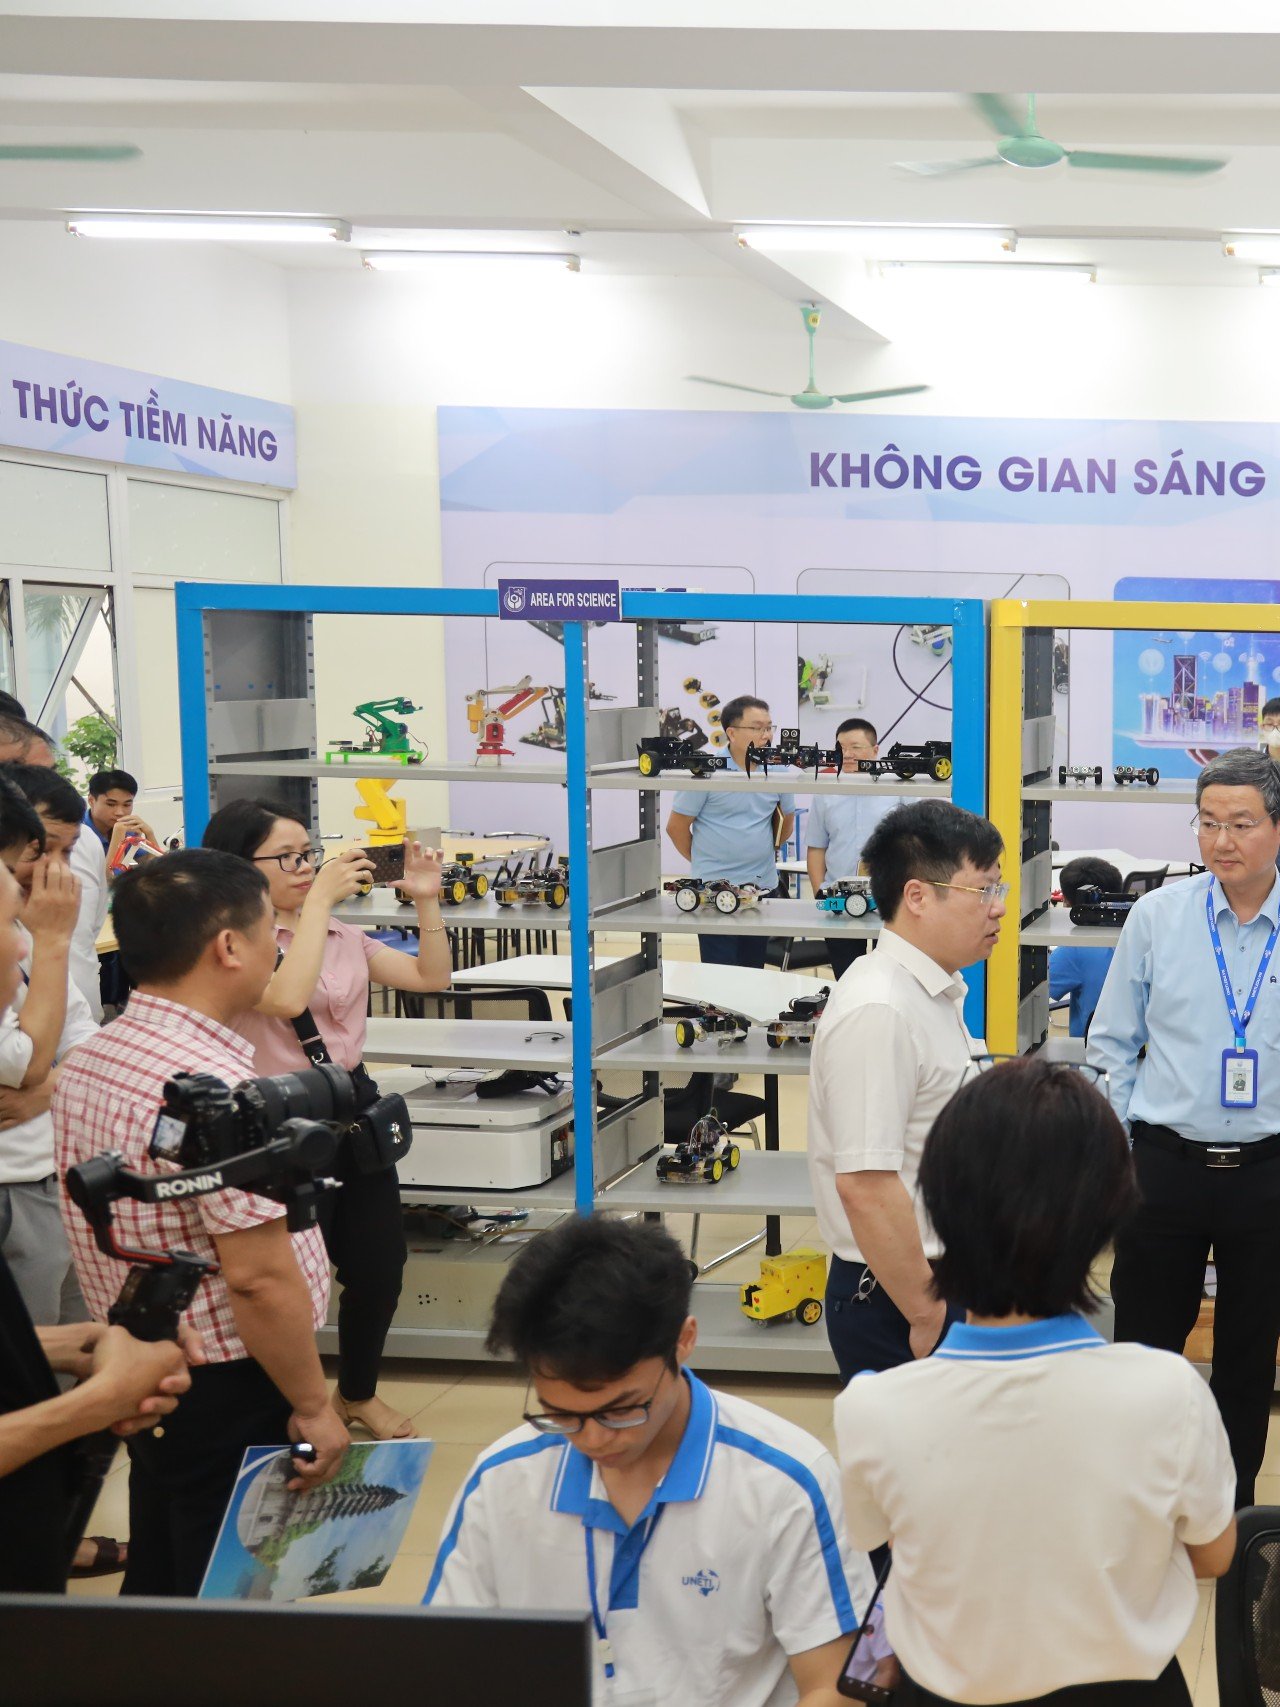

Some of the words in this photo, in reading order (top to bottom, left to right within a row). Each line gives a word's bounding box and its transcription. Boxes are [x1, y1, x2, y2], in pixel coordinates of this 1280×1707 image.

[12, 379, 110, 432] THỨC
[119, 388, 188, 447] TIỀM
[197, 412, 278, 462] NĂNG
[810, 443, 982, 491] KHÔNG
[998, 456, 1117, 494] GIAN
[1133, 449, 1267, 497] SÁNG
[530, 593, 555, 607] AREA
[557, 593, 576, 607] FOR
[577, 592, 617, 607] SCIENCE
[156, 1171, 223, 1198] RONIN
[682, 1576, 712, 1587] UNETI
